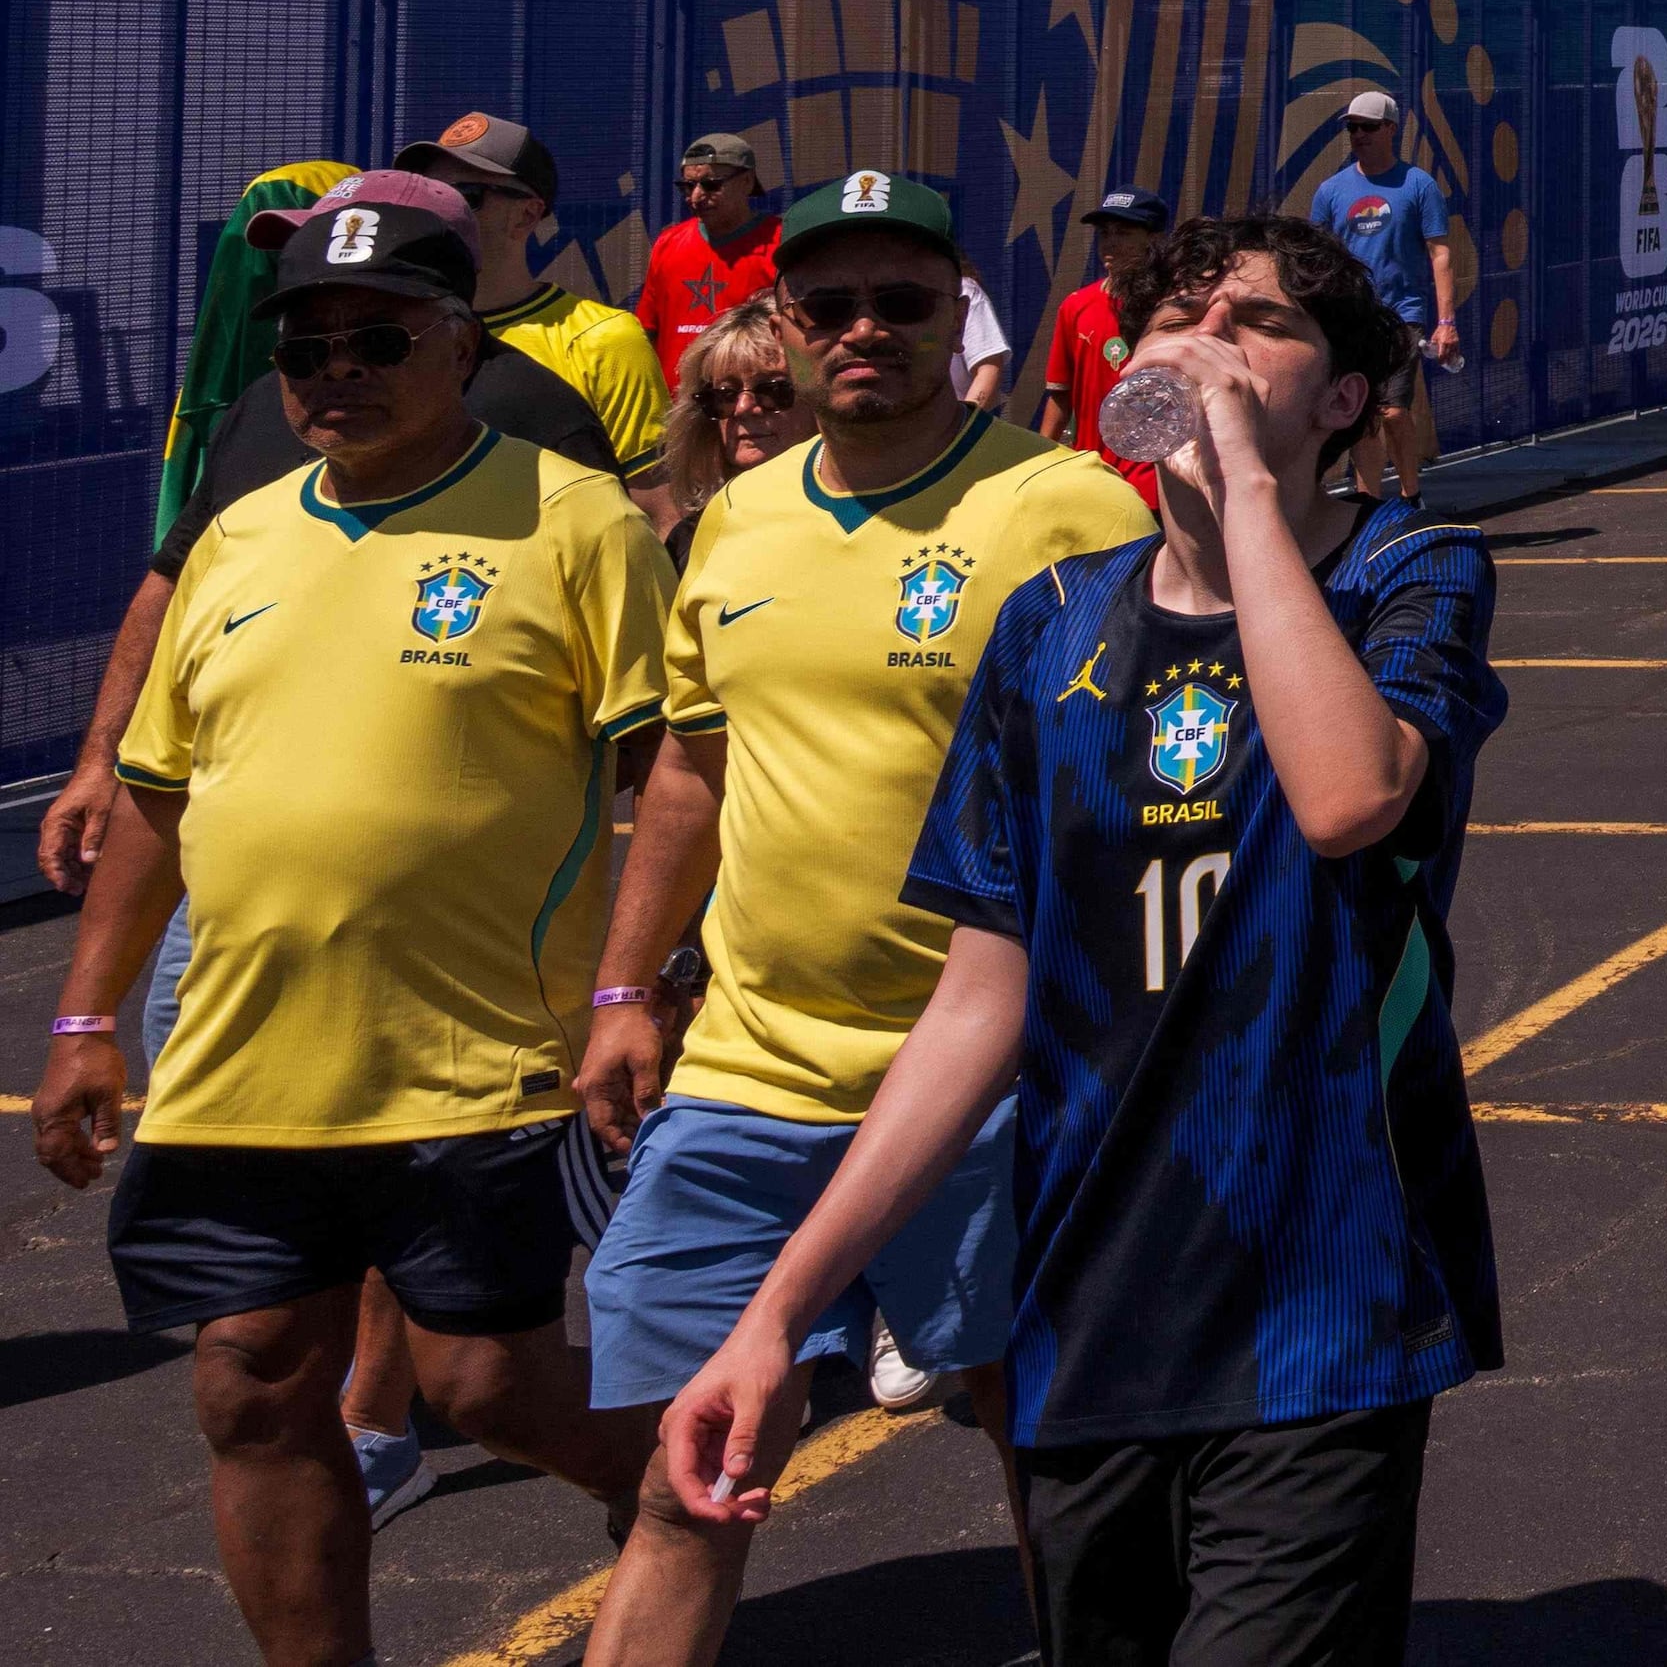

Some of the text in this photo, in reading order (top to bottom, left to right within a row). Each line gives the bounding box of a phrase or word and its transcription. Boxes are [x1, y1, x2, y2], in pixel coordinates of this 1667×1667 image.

[1636, 227, 1660, 254] FIFA
[1616, 288, 1650, 314] WORLD
[1607, 312, 1667, 355] 2026
[435, 597, 463, 610] CBF
[916, 593, 942, 608] CBF
[400, 650, 472, 668] BRASIL
[887, 651, 956, 668] BRASIL
[1174, 728, 1208, 742] CBF
[1142, 800, 1223, 826] BRASIL
